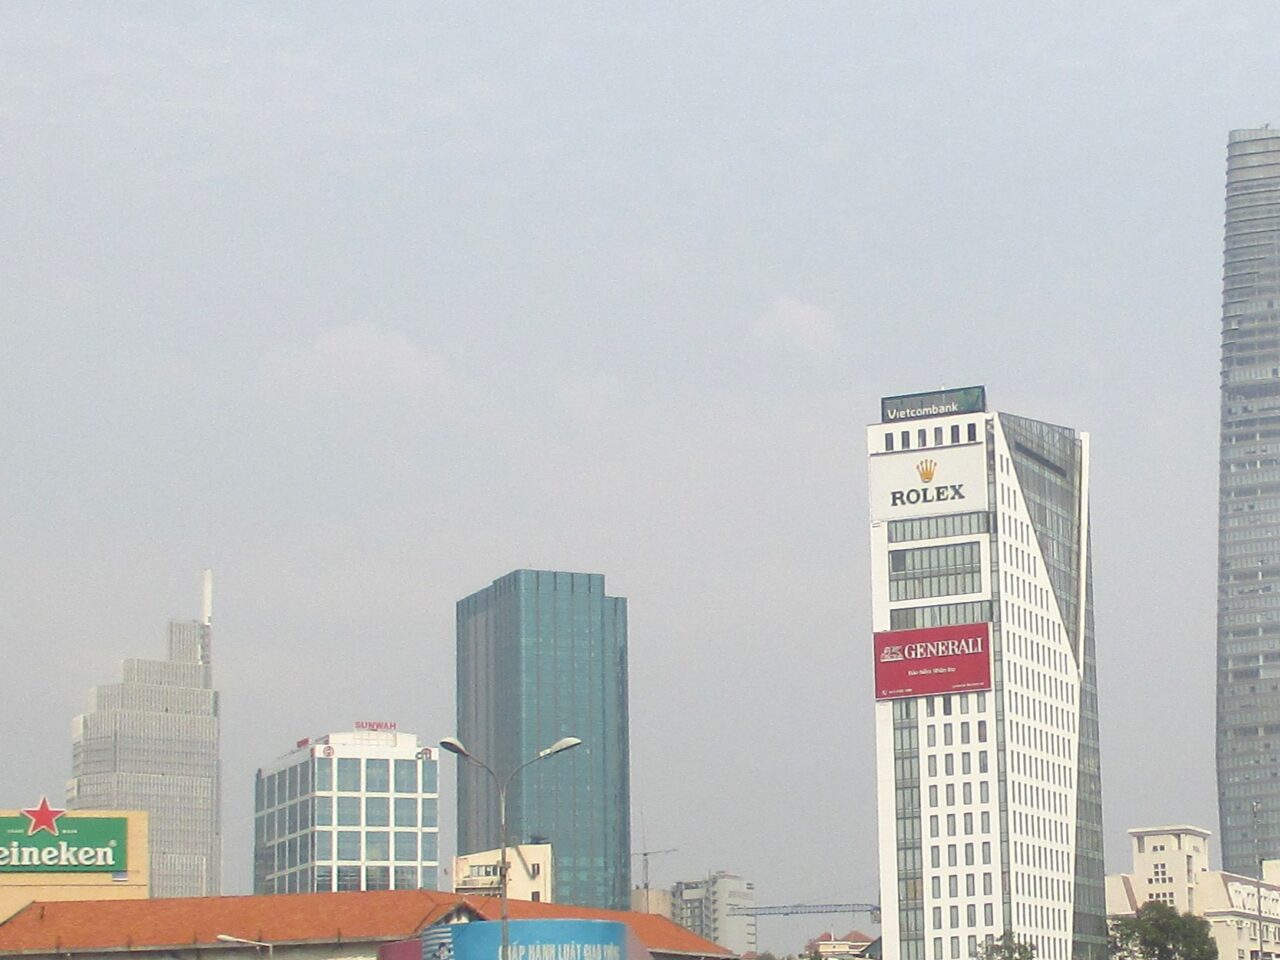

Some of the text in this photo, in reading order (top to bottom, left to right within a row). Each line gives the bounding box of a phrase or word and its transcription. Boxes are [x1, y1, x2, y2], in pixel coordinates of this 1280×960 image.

[888, 402, 959, 419] Vietcombank
[891, 484, 966, 507] ROLEX
[904, 637, 983, 659] GENERALI
[355, 721, 397, 730] SUNWAH
[0, 841, 116, 866] eineken
